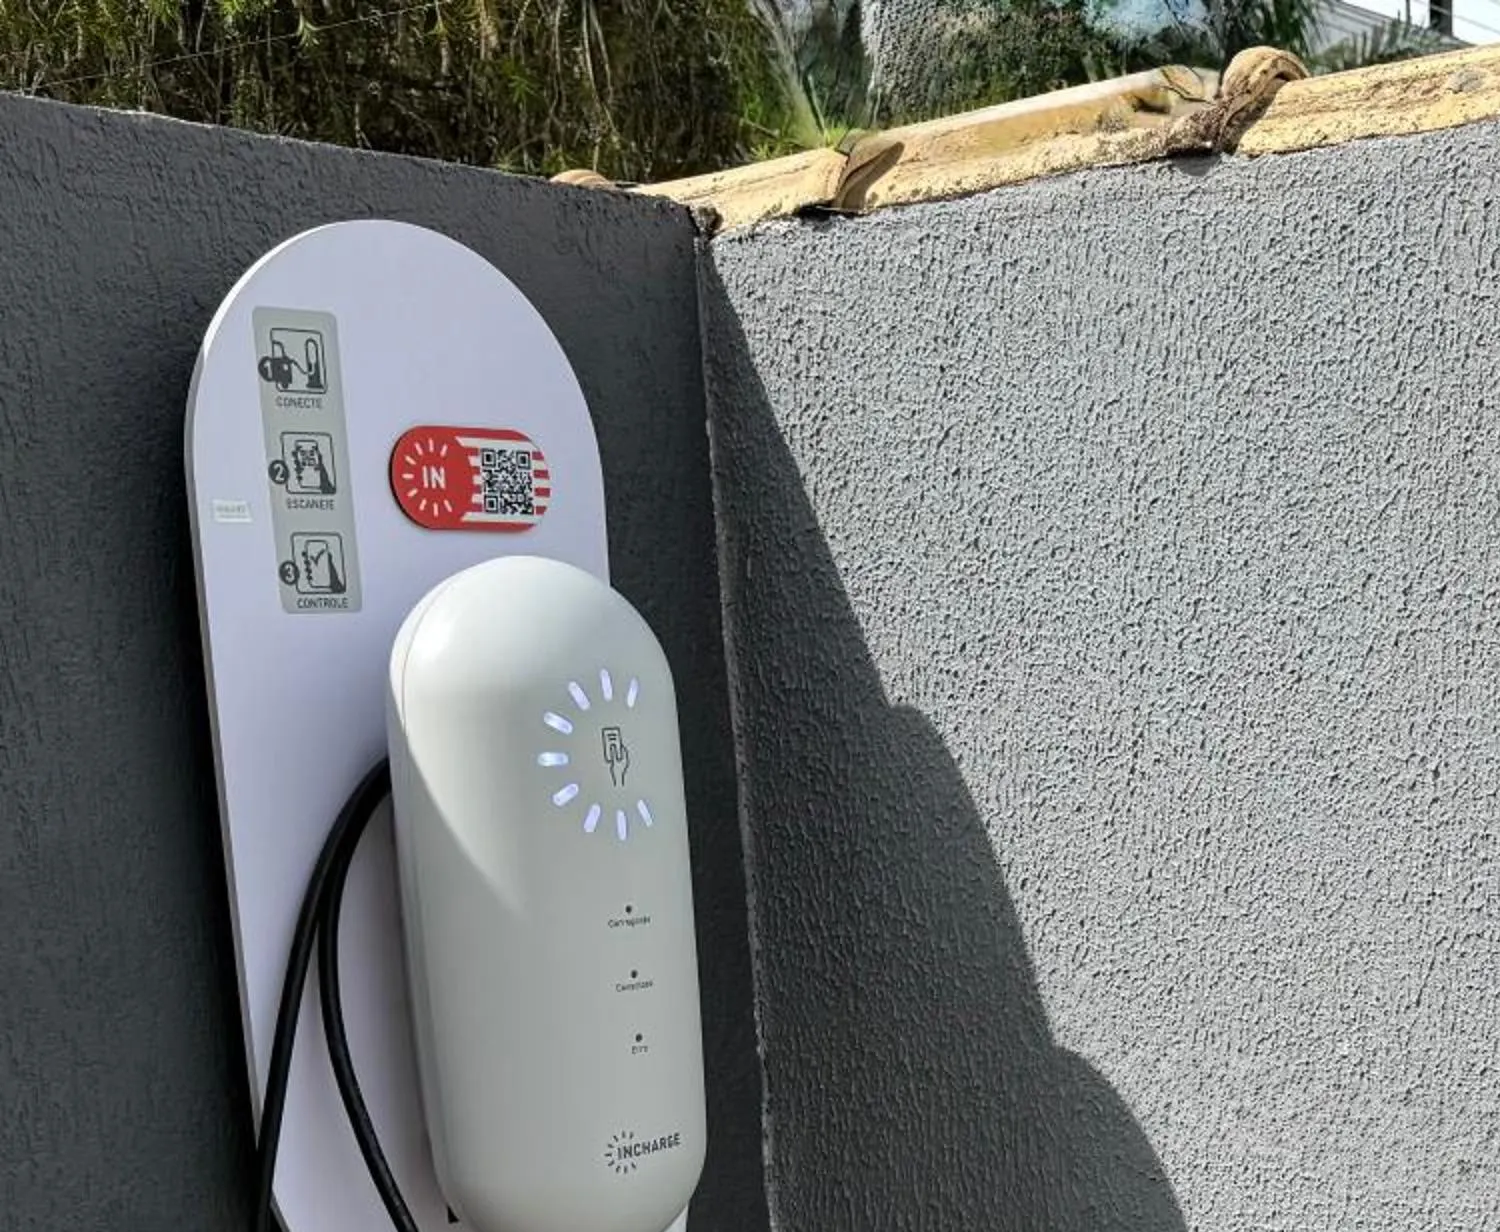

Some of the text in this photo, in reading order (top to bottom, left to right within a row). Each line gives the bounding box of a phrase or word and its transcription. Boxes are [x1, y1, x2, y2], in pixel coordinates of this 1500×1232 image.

[275, 395, 323, 409] CONECTE
[273, 462, 285, 481] 2
[422, 465, 447, 489] IN
[284, 563, 295, 582] 3
[296, 597, 349, 609] CONTROLE
[617, 1132, 681, 1161] INCHARGE
